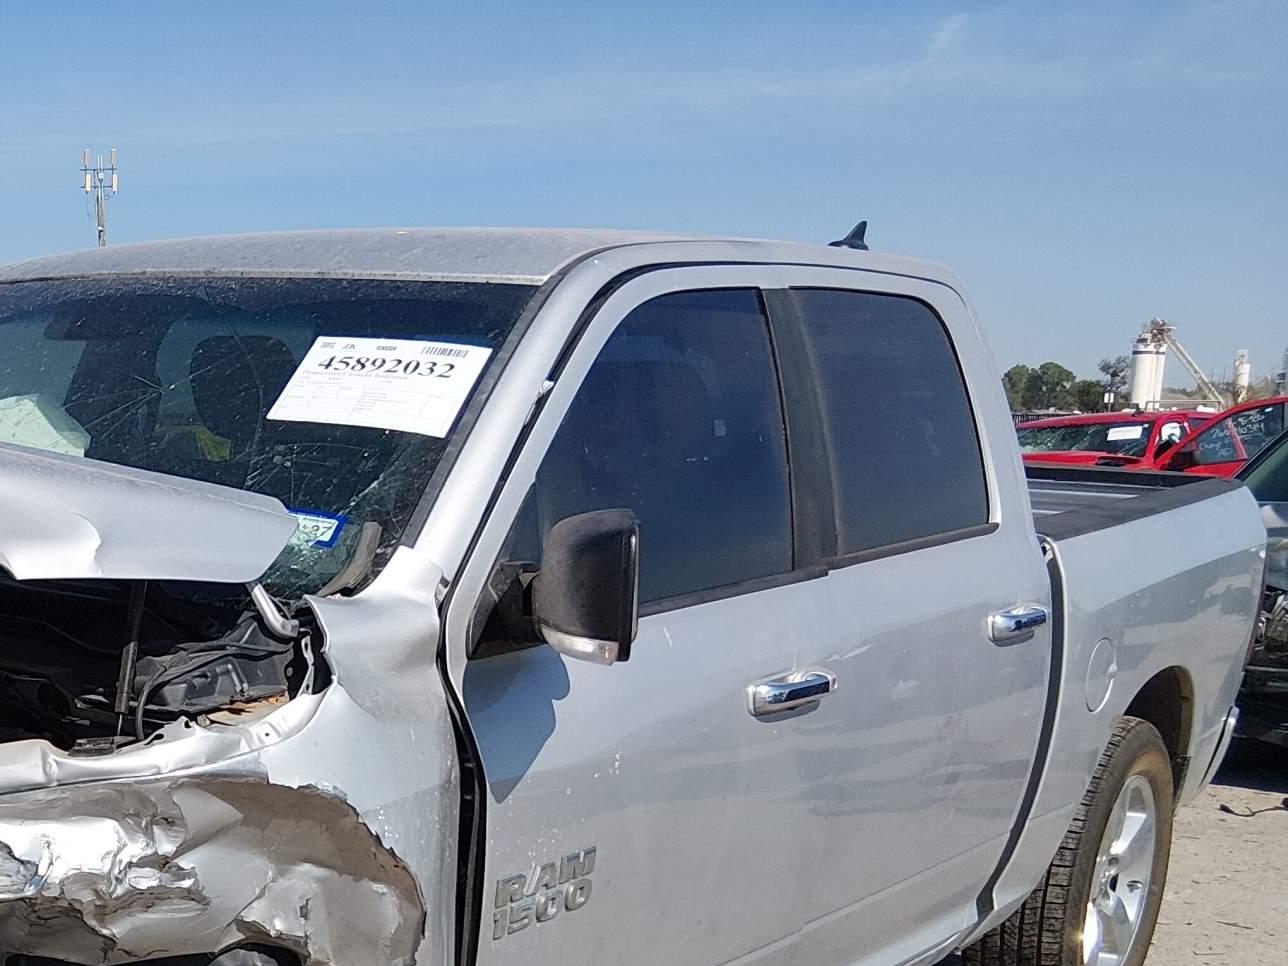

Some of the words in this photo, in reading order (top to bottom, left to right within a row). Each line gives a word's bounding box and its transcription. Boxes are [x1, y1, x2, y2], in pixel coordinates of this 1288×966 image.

[318, 355, 455, 379] 45892032
[495, 845, 597, 910] RAM
[492, 878, 593, 941] 1500
